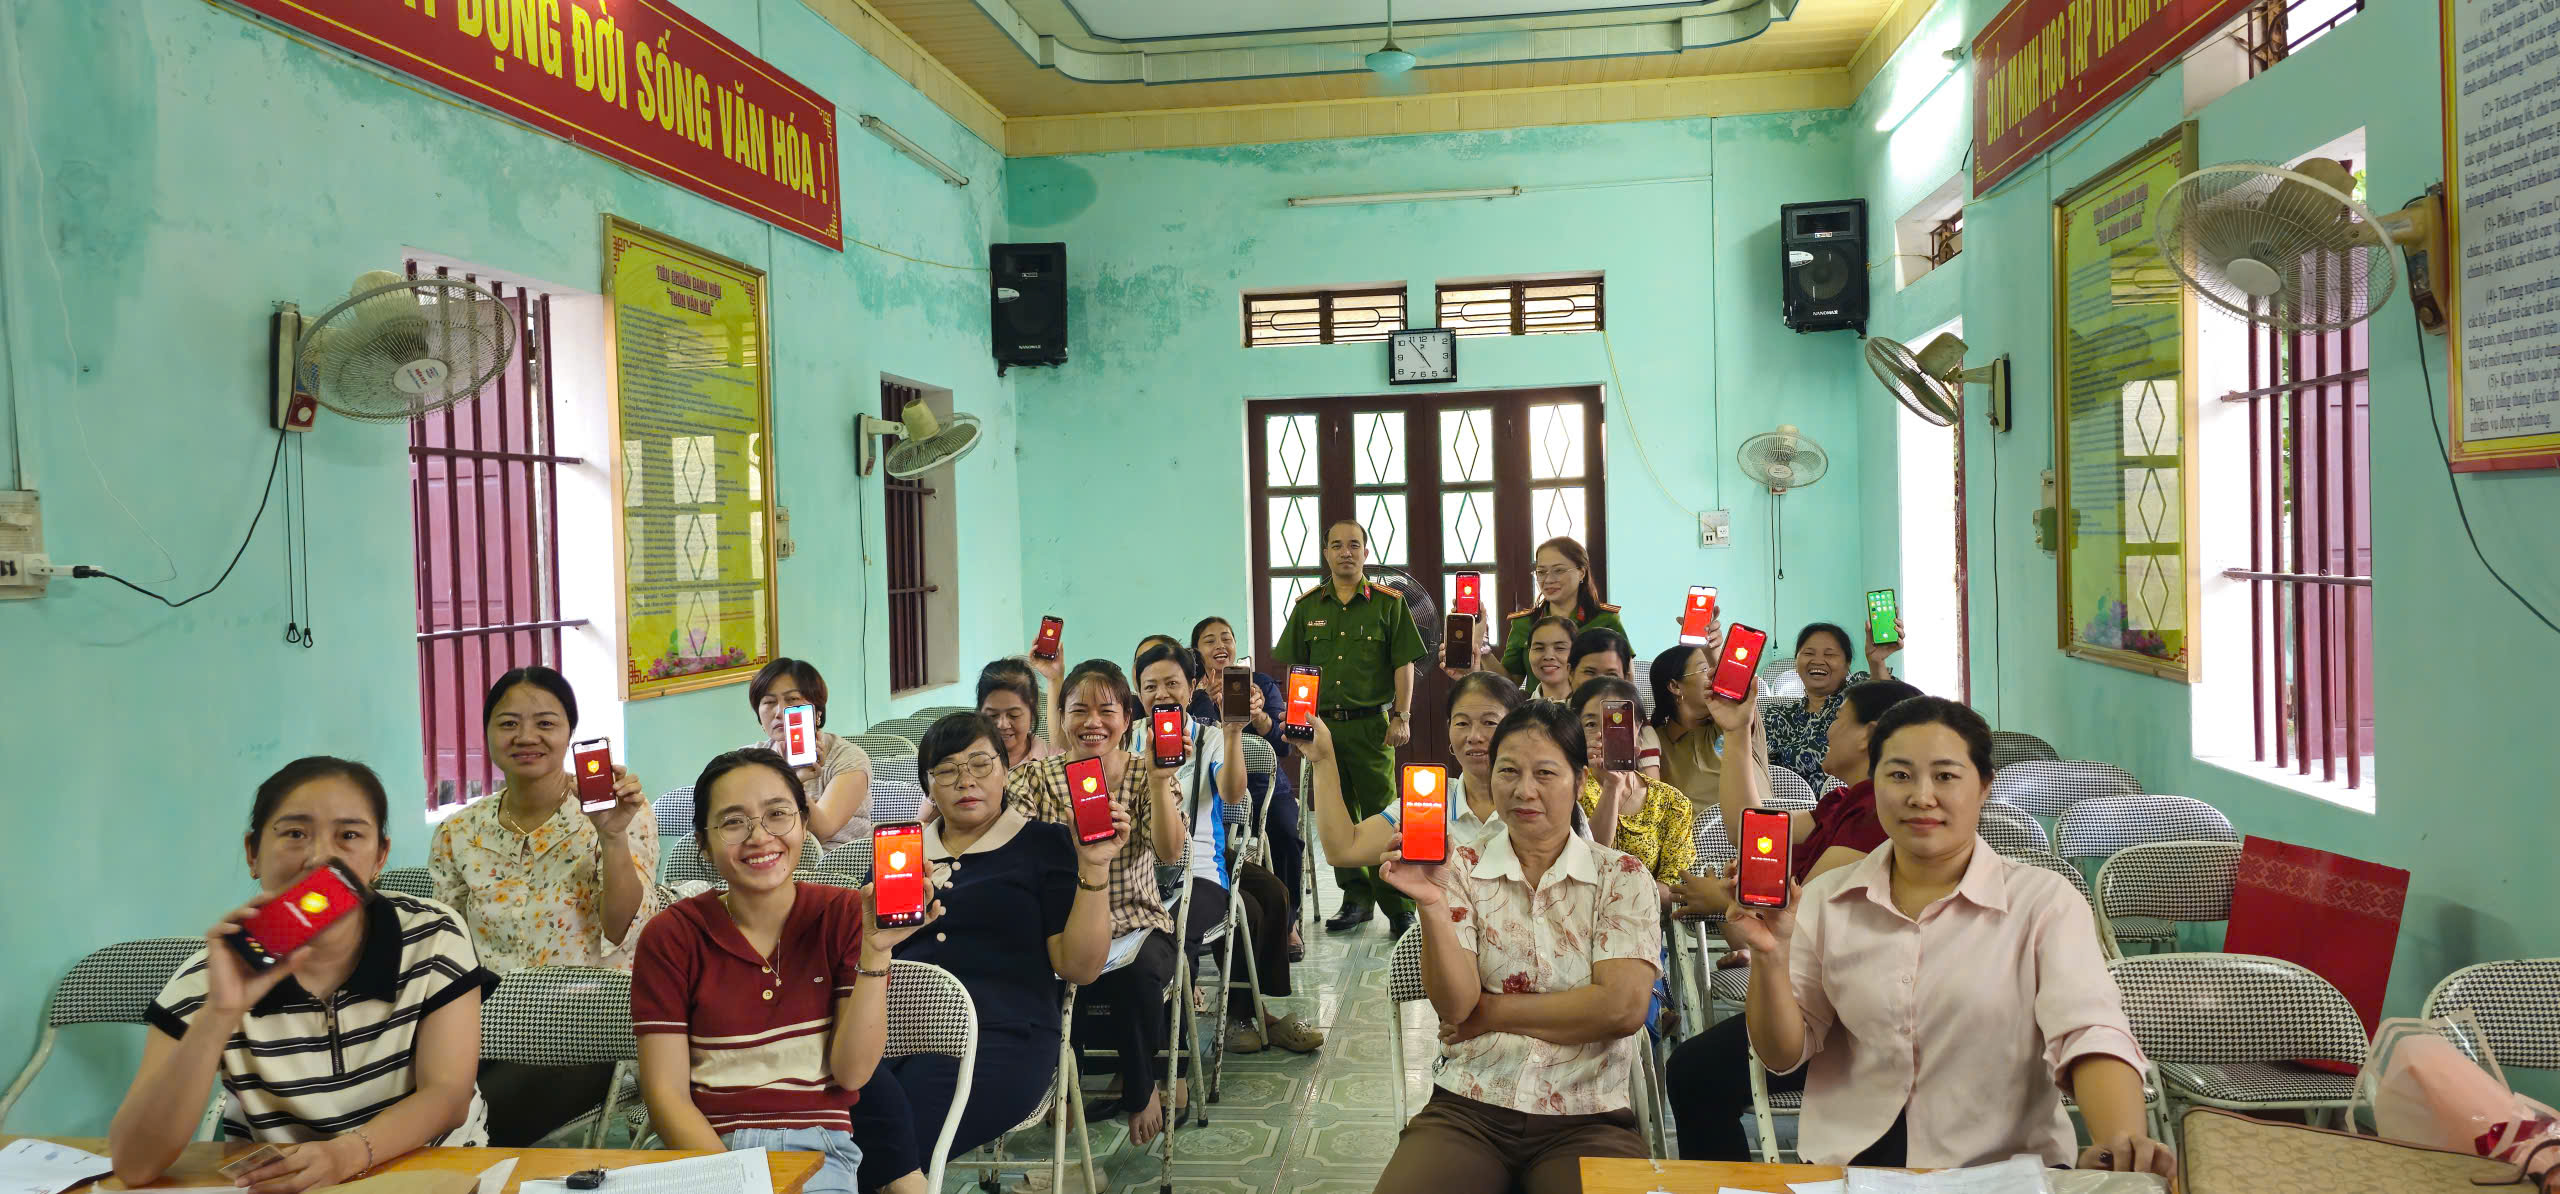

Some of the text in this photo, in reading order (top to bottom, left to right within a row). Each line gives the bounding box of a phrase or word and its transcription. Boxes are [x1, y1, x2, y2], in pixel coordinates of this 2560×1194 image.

[636, 29, 713, 150] SỐNG
[717, 80, 768, 176] VĂN
[771, 112, 816, 199] HÓA
[2007, 35, 2040, 137] MẠNH
[2042, 11, 2065, 112] HỌC
